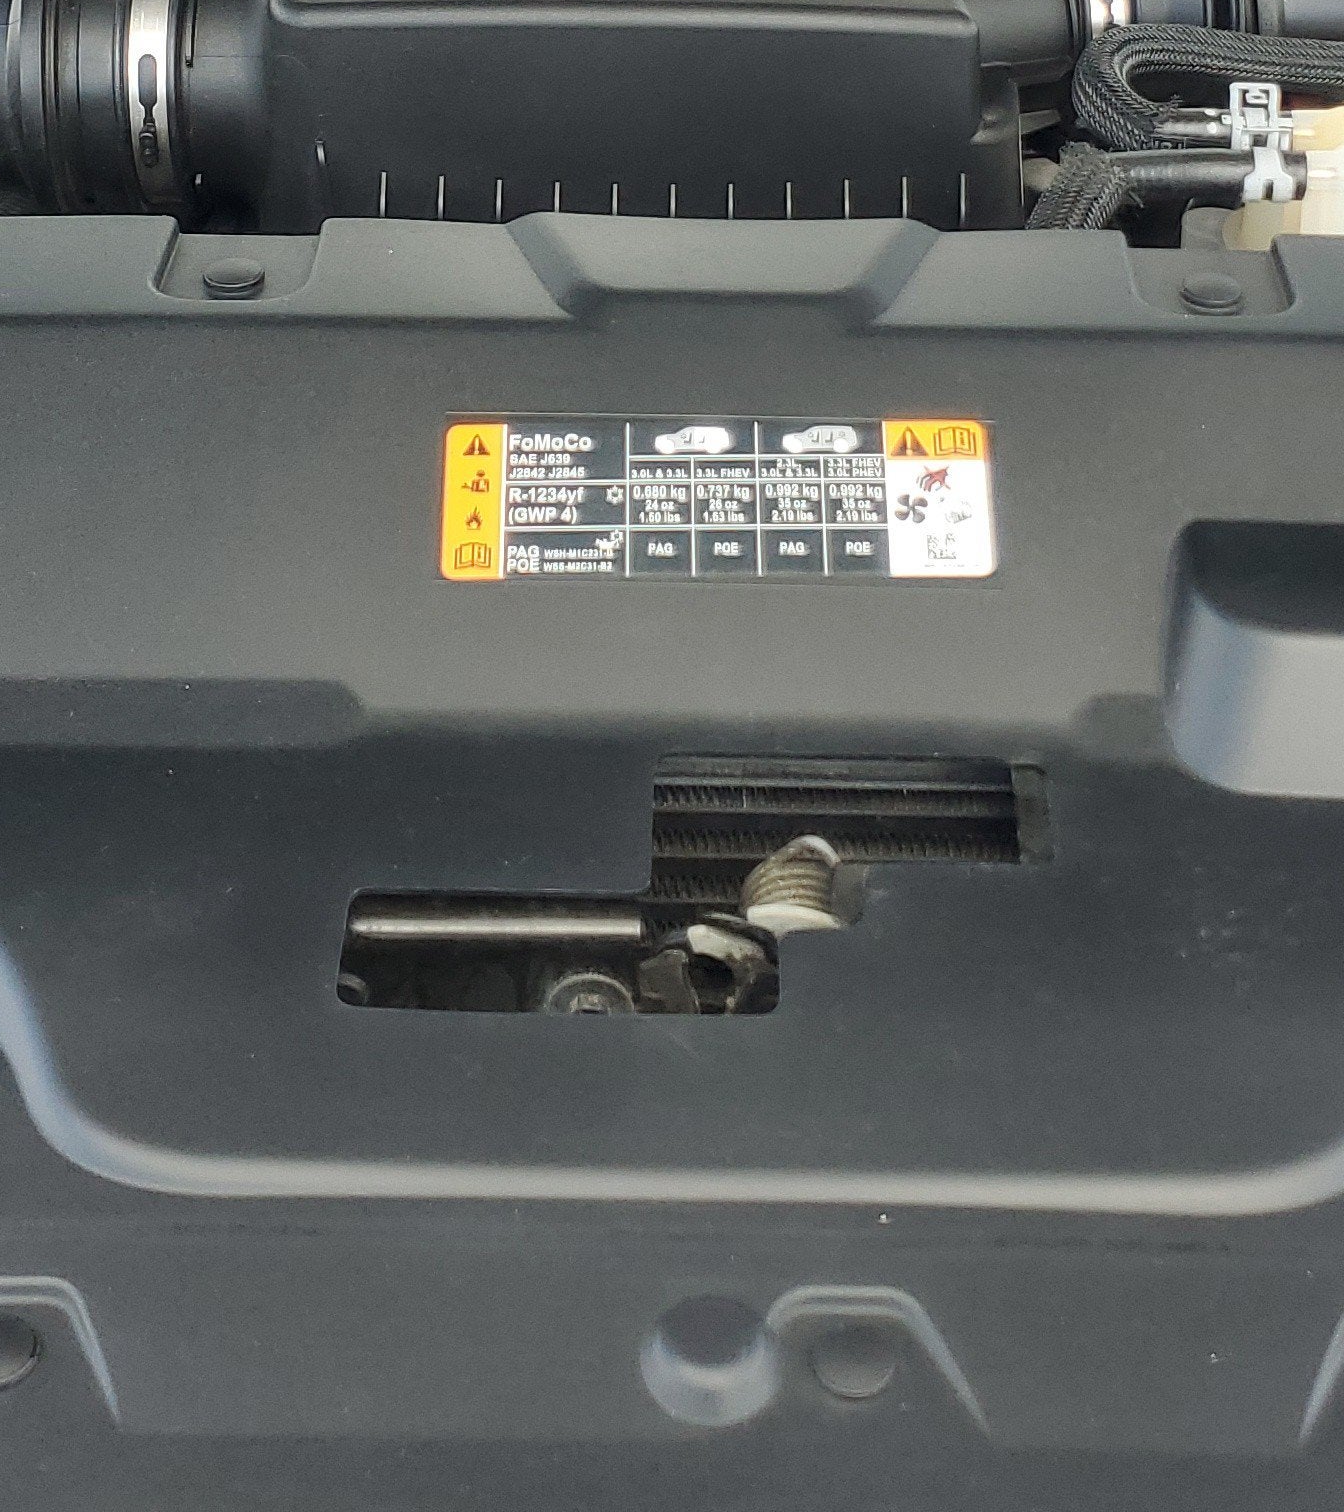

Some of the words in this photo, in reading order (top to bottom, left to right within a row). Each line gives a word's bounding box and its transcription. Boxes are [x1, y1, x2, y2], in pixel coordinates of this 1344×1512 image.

[509, 433, 592, 451] FoMoCo
[509, 453, 537, 465] SAE
[540, 453, 571, 465] J639
[827, 457, 850, 467] 3.3L
[851, 456, 882, 467] FHEV
[655, 468, 664, 478] &
[666, 468, 688, 478] 3.3L
[696, 468, 719, 478] 3.3L
[720, 467, 750, 478] FHEV
[785, 468, 794, 478] &
[796, 468, 818, 478] 3.3L
[852, 467, 883, 478] PHEV
[509, 486, 584, 506] R-1234yf
[670, 484, 687, 501] kg
[696, 484, 731, 498] 0.737
[733, 484, 750, 501] kg
[765, 483, 800, 497] 0.992
[802, 483, 820, 500] kg
[829, 483, 864, 497] 0.992
[866, 483, 883, 500] kg
[644, 499, 659, 510] 24
[660, 501, 676, 510] oz
[724, 501, 739, 510] oz
[793, 500, 808, 509] oz
[857, 500, 873, 509] oz
[509, 506, 557, 524] (GWP
[560, 506, 578, 524] 4)
[663, 511, 681, 523] lbs
[727, 511, 746, 523] lbs
[796, 509, 815, 522] lbs
[860, 510, 878, 522] lbs
[507, 545, 541, 558] PAG
[647, 542, 674, 555] PAG
[713, 541, 740, 555] POE
[778, 541, 807, 555] PAG
[845, 541, 873, 555] POE
[506, 558, 540, 573] POE
